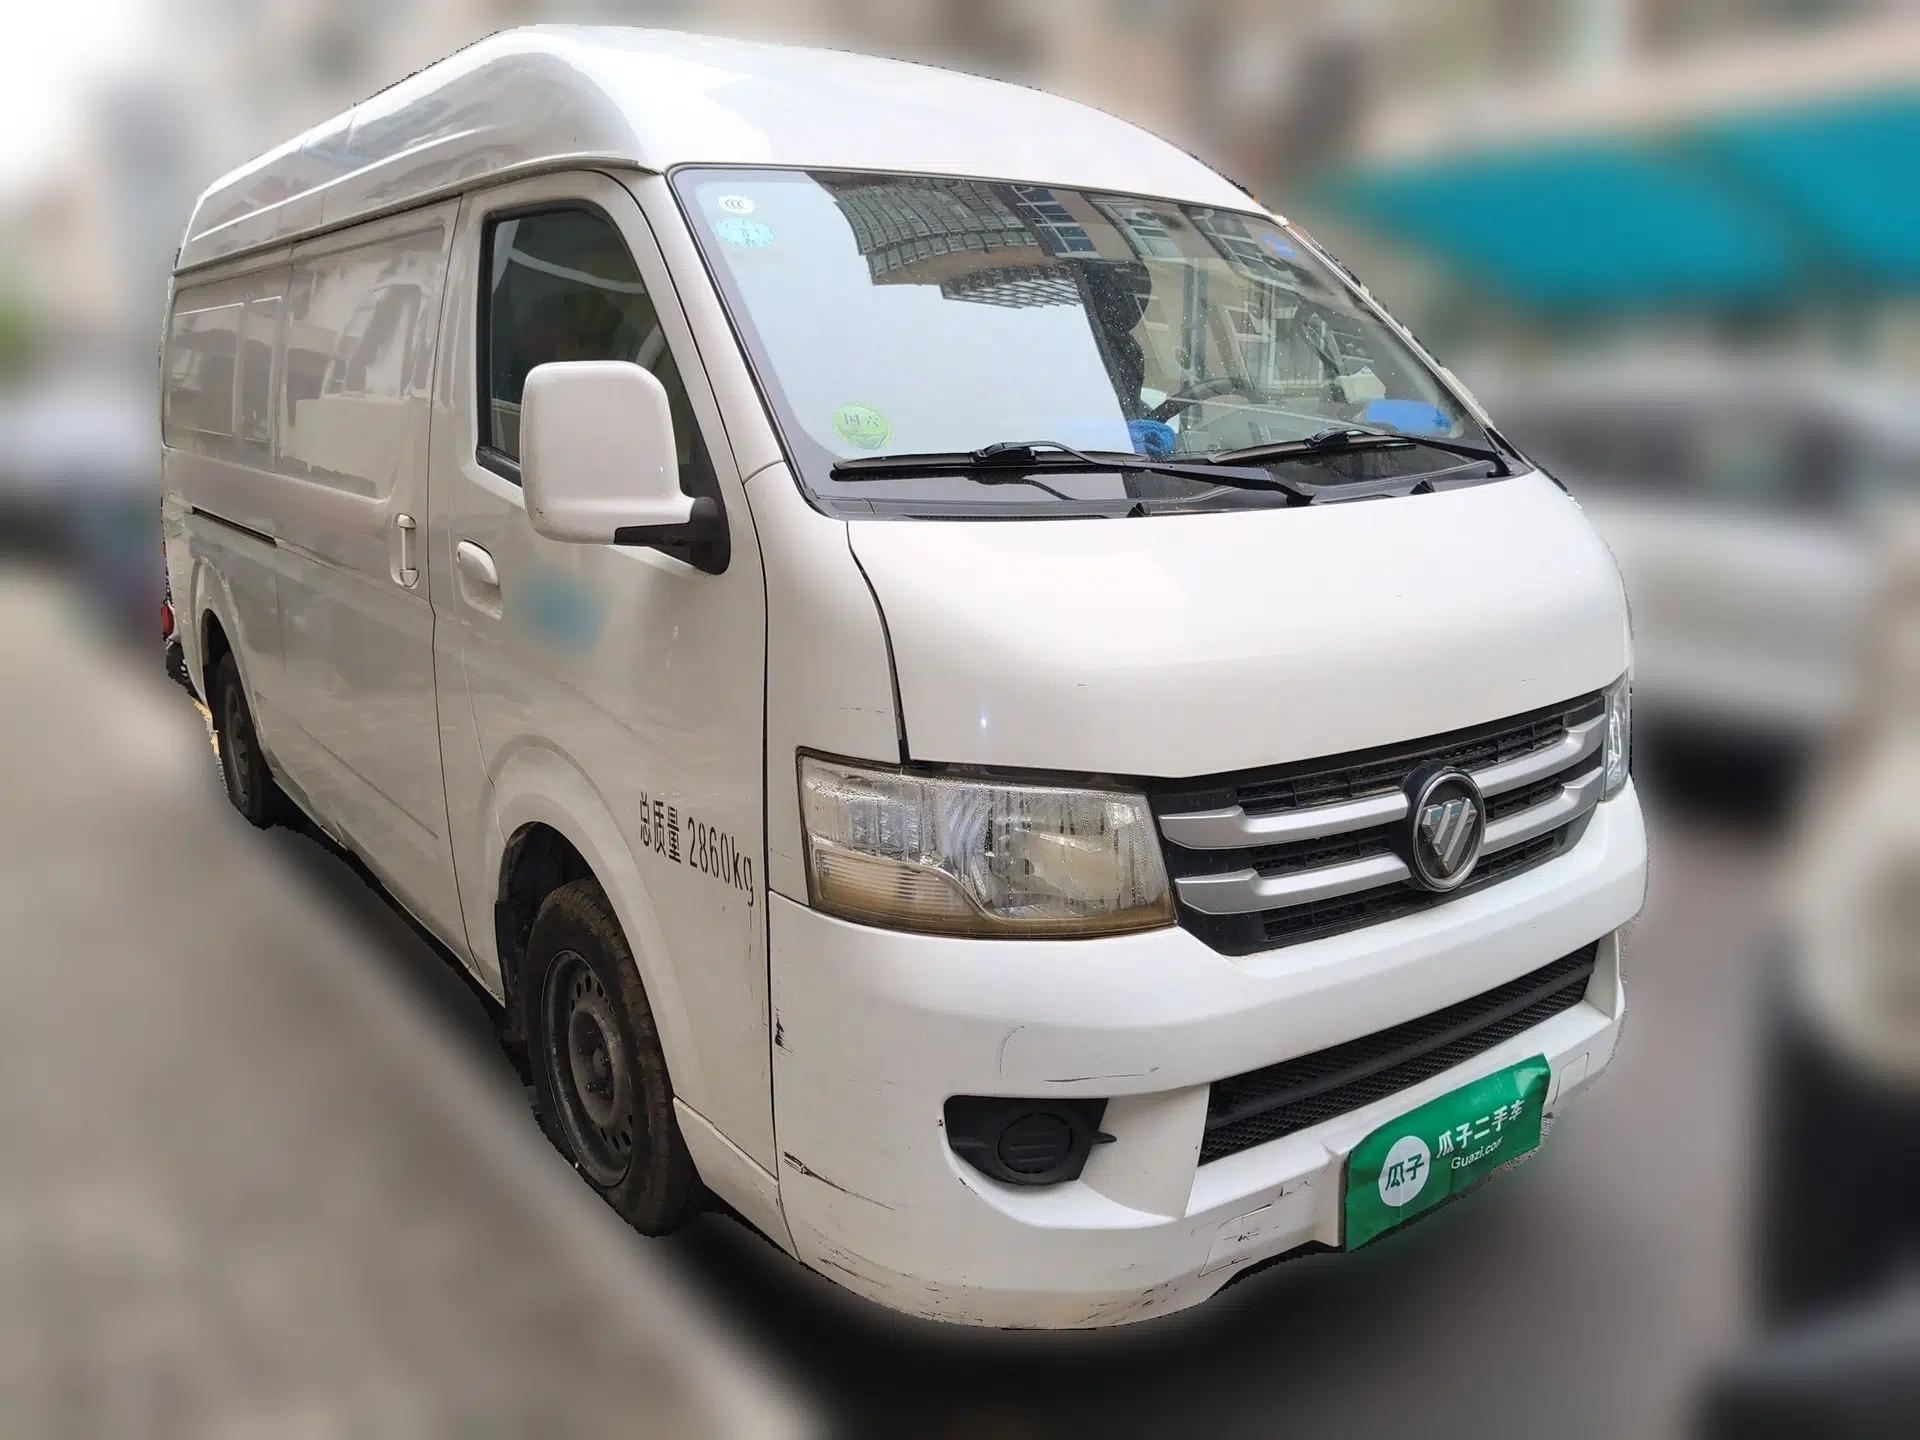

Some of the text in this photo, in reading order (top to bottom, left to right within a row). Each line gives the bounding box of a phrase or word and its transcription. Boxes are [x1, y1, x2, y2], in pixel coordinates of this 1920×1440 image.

[640, 790, 754, 907] 总质量 2860kg
[1436, 1100, 1525, 1158] 瓜子二手车
[1385, 1153, 1425, 1191] 瓜子
